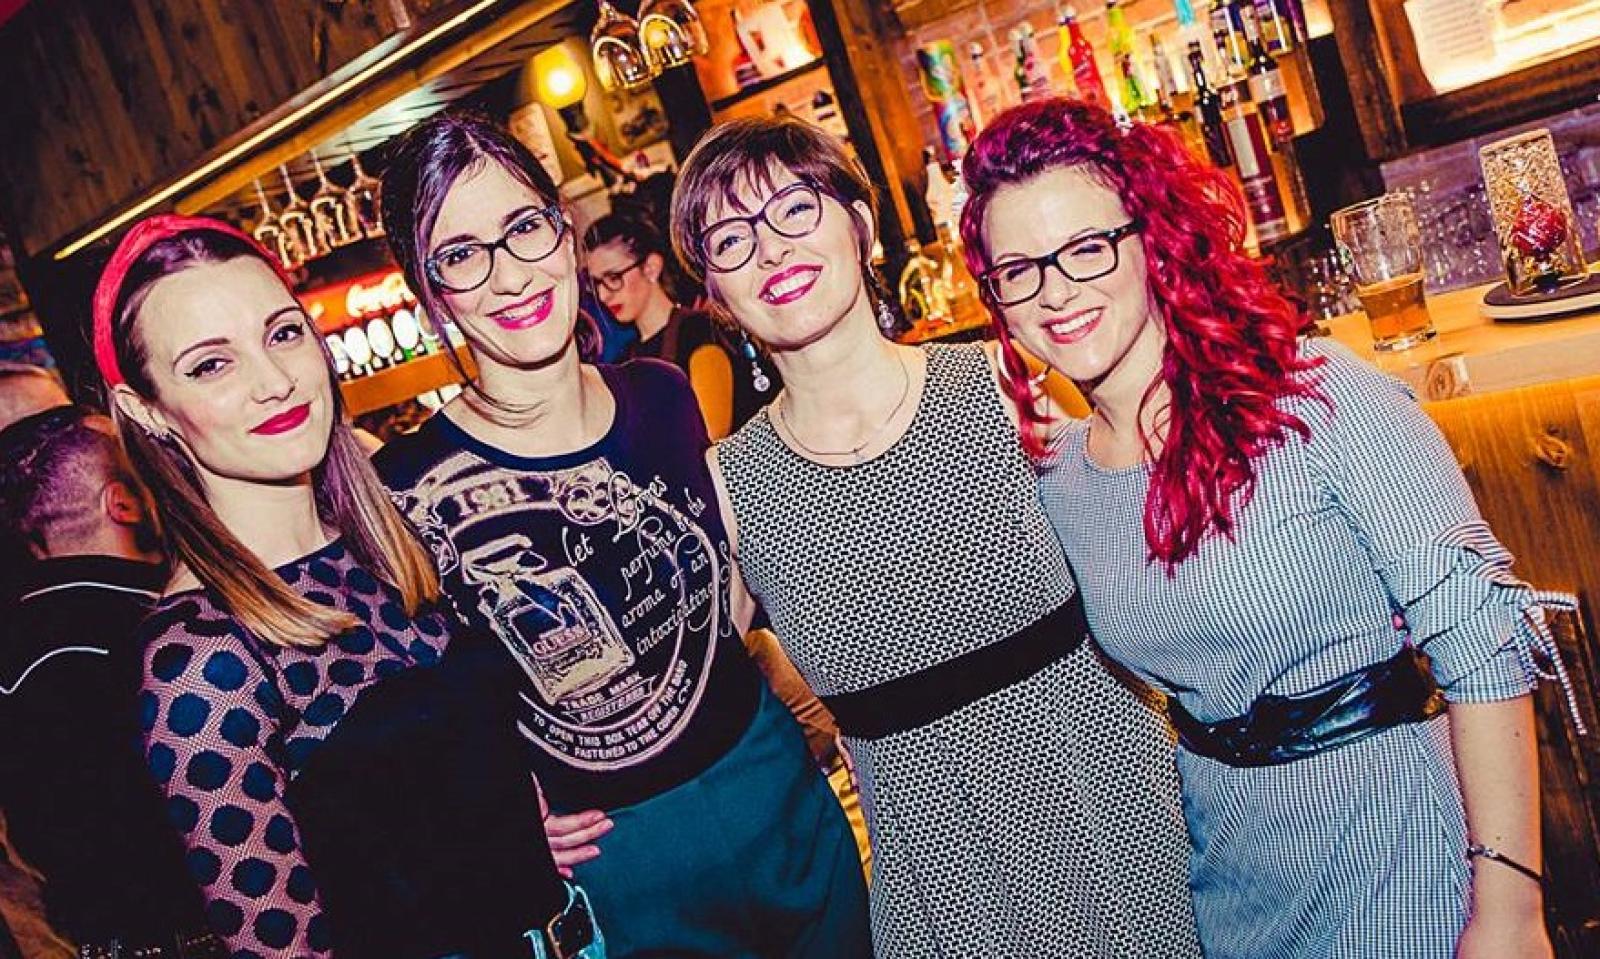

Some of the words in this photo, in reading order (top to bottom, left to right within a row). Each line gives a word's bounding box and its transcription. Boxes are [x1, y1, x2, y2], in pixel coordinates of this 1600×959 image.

[621, 588, 666, 627] aroma
[690, 551, 709, 573] an
[560, 692, 605, 711] TRADE
[608, 671, 644, 695] MARK
[532, 713, 545, 727] TO
[549, 724, 574, 744] OPEN
[577, 734, 601, 747] THIS
[605, 732, 626, 746] BOX
[625, 718, 650, 737] TEAR
[574, 746, 626, 760] FASTENED
[626, 741, 639, 753] TO
[638, 726, 659, 745] THE
